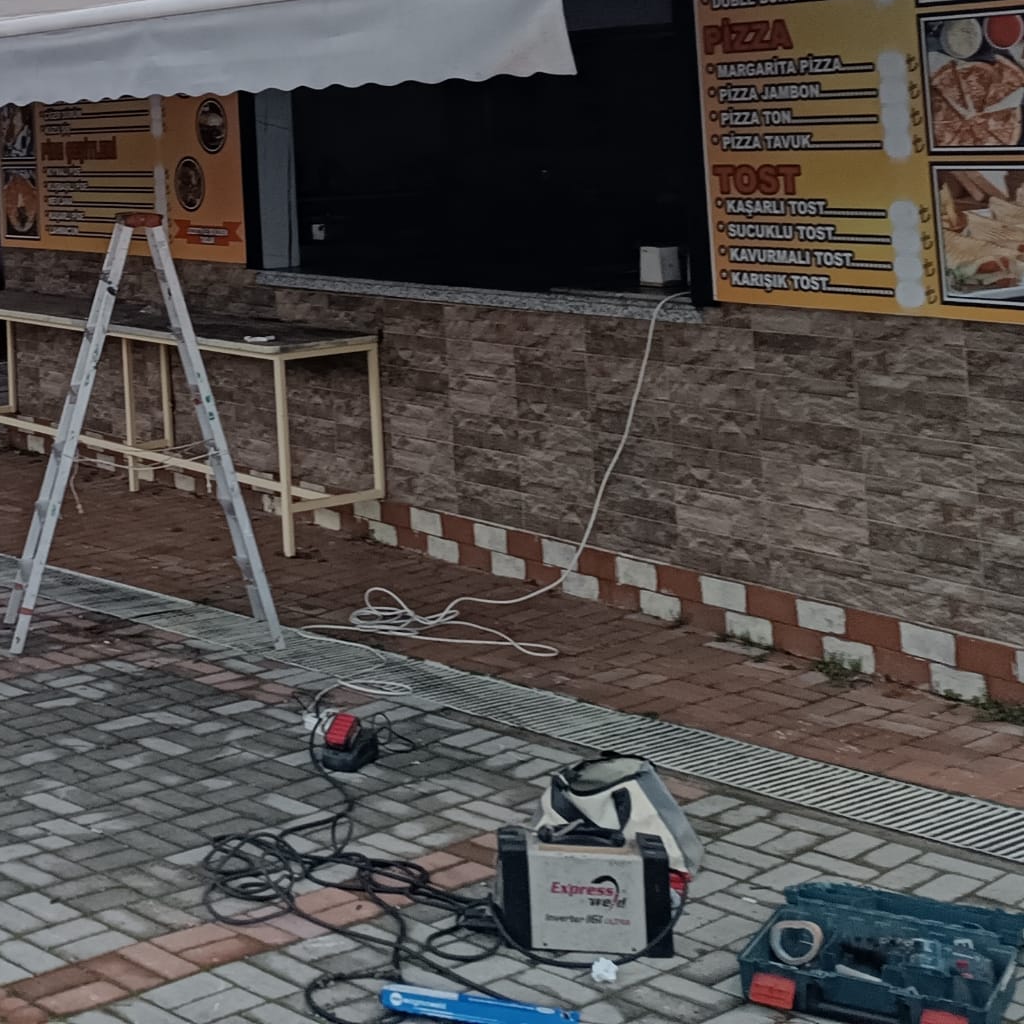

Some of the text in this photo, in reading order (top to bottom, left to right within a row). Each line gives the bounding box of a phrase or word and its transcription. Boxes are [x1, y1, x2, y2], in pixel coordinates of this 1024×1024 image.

[703, 17, 793, 55] PİZZA
[717, 56, 796, 78] MARGARİTA
[799, 54, 842, 74] PİZZA
[719, 84, 758, 102] PİZZA
[761, 82, 820, 100] JAMBON
[720, 108, 760, 126] PİZZA
[763, 108, 792, 125] TON
[722, 131, 761, 149] PİZZA
[764, 132, 812, 149] TAVUK
[713, 164, 801, 195] TOST
[726, 199, 785, 218] KAŞARLI
[788, 200, 826, 216] TOST
[728, 222, 793, 240] SUCUKLU
[796, 225, 835, 241] TOST
[729, 246, 811, 265] KAVURMALI
[814, 250, 853, 267] TOST
[731, 271, 788, 291] KARIŞIK
[791, 274, 829, 292] TOST
[550, 881, 614, 897] Express
